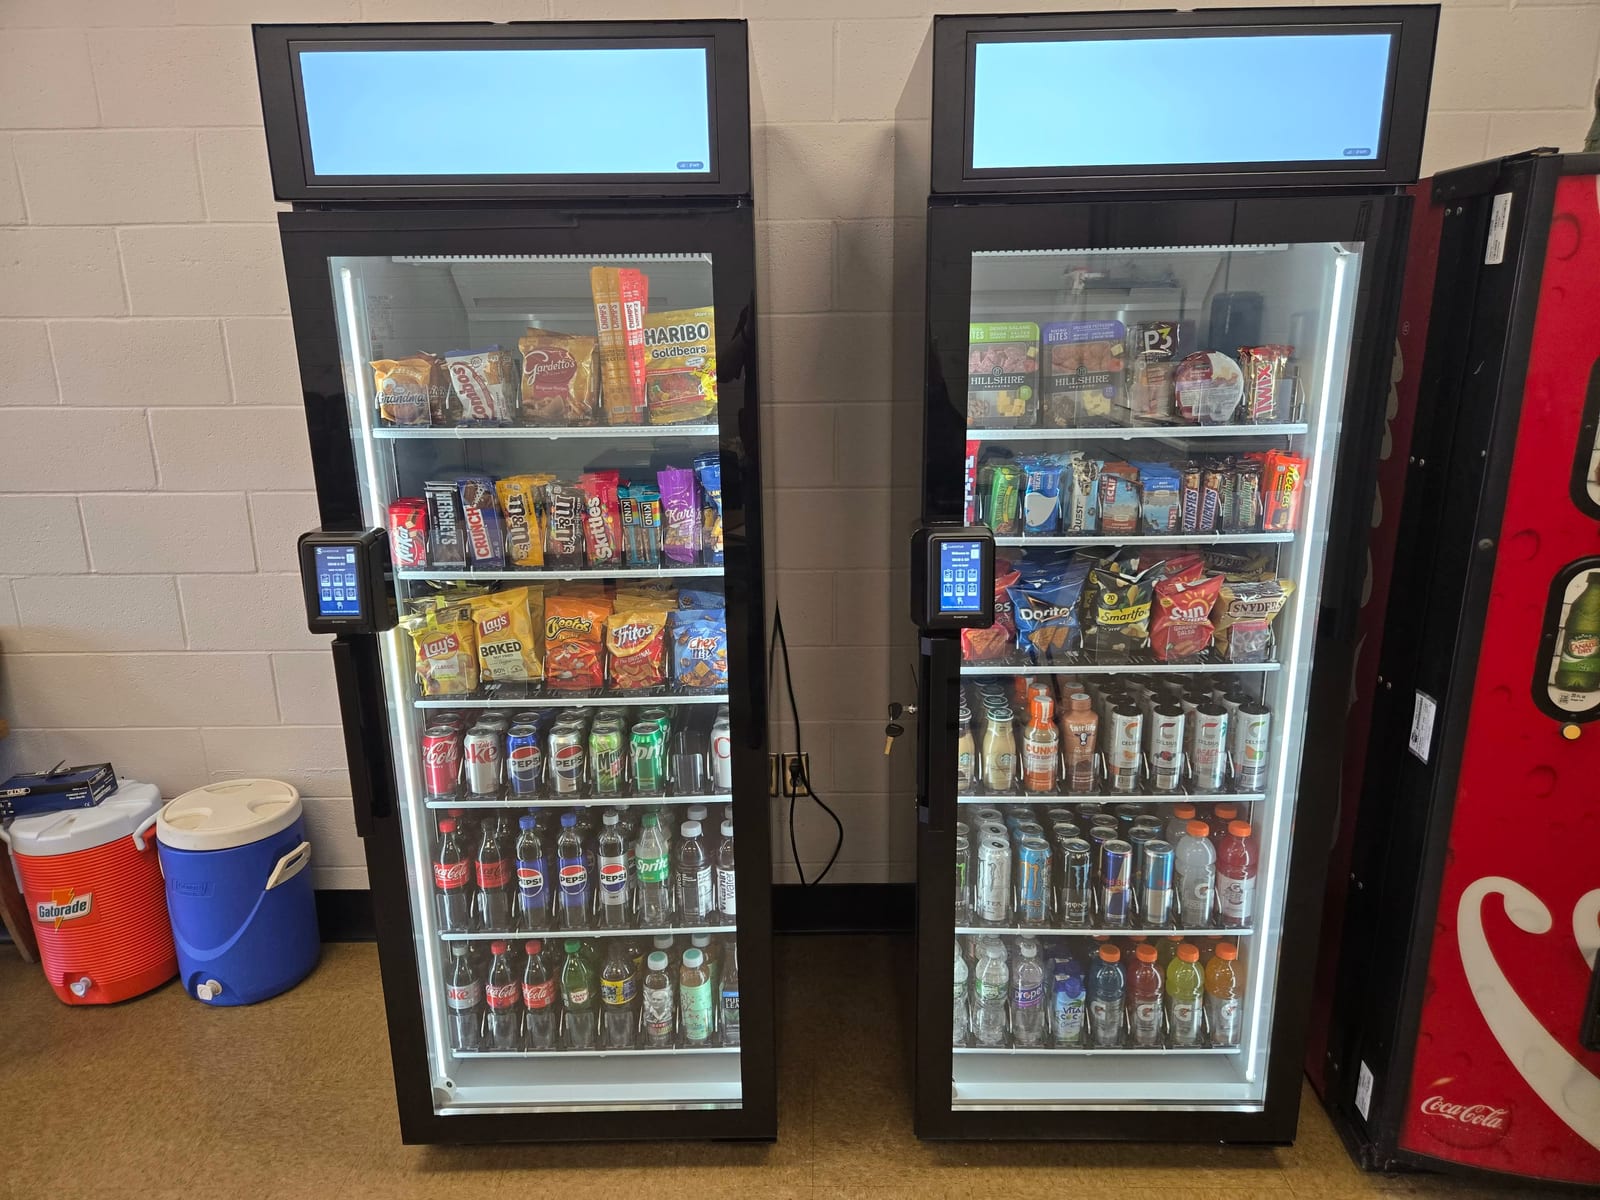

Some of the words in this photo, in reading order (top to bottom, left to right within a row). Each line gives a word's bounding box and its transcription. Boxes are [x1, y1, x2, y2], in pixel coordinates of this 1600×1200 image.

[644, 323, 710, 346] HARIBO
[1144, 327, 1172, 351] P3
[652, 345, 707, 359] Goldbears
[523, 350, 576, 386] Gardetto's
[971, 376, 1025, 385] HILLSHIRE
[1055, 375, 1109, 386] HILLSHIRE
[1255, 364, 1275, 416] TWIX
[622, 501, 633, 524] KIND
[643, 504, 653, 526] KIND
[1073, 505, 1084, 531] QUEST
[1200, 489, 1218, 530] SNICKERS
[466, 506, 491, 558] CRUNCH
[587, 497, 613, 559] Skittles
[1020, 606, 1070, 621] Dorito
[1101, 607, 1147, 622] Smartfo
[1169, 605, 1206, 620] Sun
[482, 615, 508, 635] Lay's
[546, 614, 593, 640] Cheetos
[611, 622, 653, 647] Fritos
[423, 636, 456, 658] Lay's
[480, 641, 522, 658] BAKED
[637, 857, 669, 874] Sprite
[560, 874, 587, 885] PEPSI
[600, 873, 627, 883] PEPSI
[38, 900, 88, 918] Gatorade
[1420, 1095, 1509, 1129] Coca-Cola
